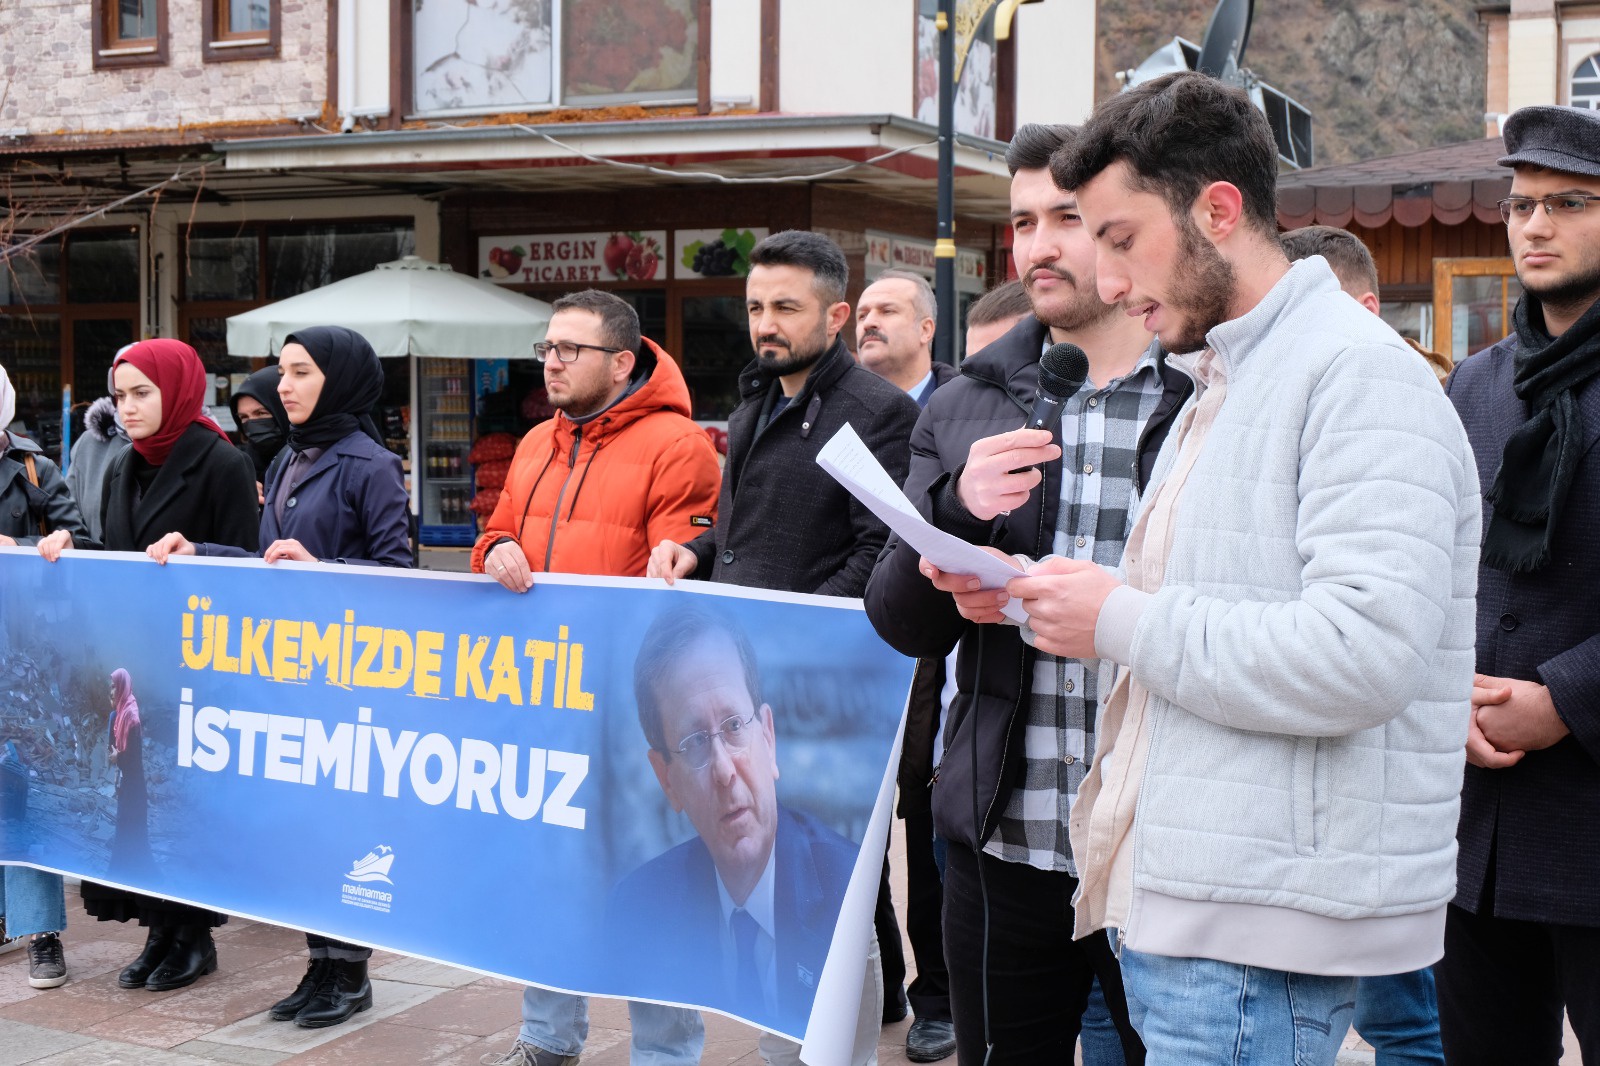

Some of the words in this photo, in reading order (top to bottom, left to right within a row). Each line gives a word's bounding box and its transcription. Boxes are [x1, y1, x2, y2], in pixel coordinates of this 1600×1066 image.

[180, 595, 449, 701] ÜLKEMİZDE
[455, 625, 595, 711] KATİL
[177, 688, 589, 830] İSTEMİYORUZ
[342, 883, 392, 902] mavimarmara
